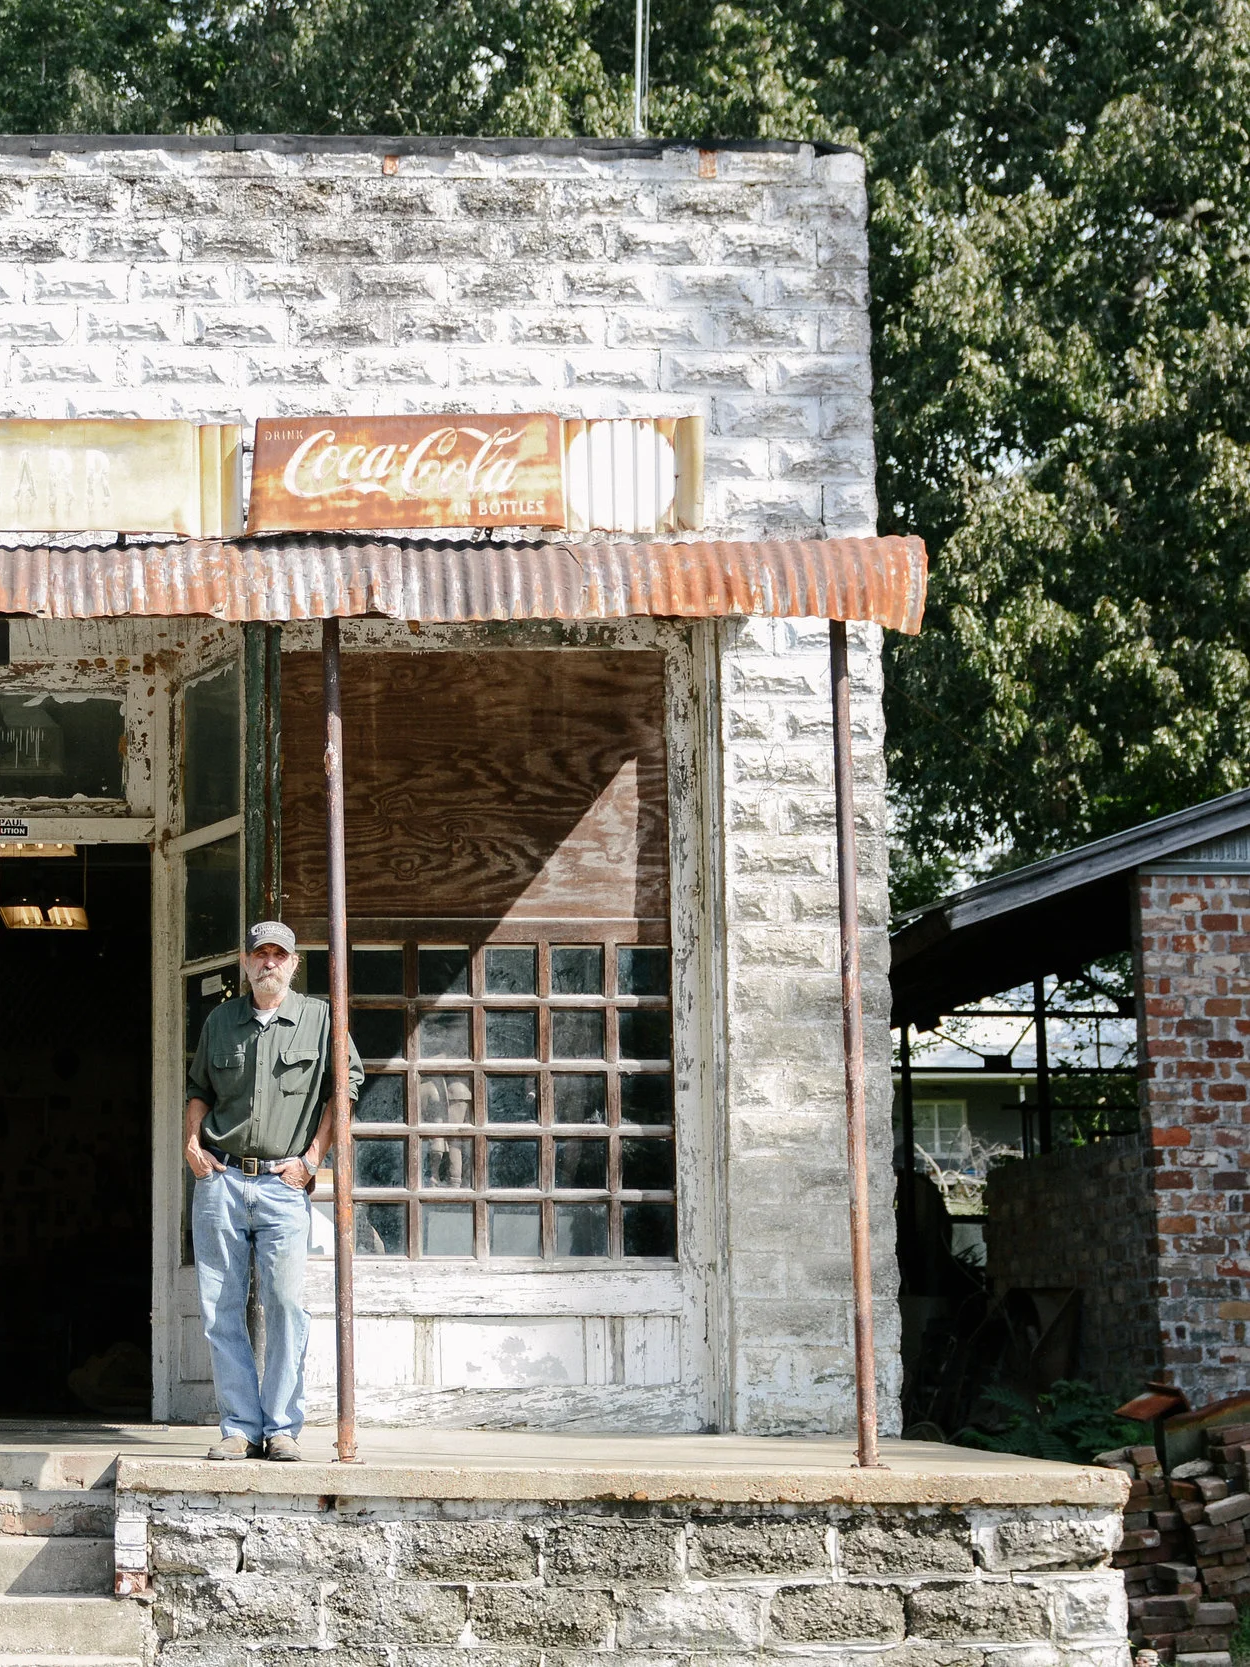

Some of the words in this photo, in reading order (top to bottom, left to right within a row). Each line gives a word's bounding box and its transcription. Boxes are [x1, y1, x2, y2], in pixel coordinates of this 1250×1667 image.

[265, 429, 304, 441] DRINK
[284, 427, 526, 497] Coca-Cola
[454, 502, 471, 515] IN
[479, 501, 545, 515] BOTTLES
